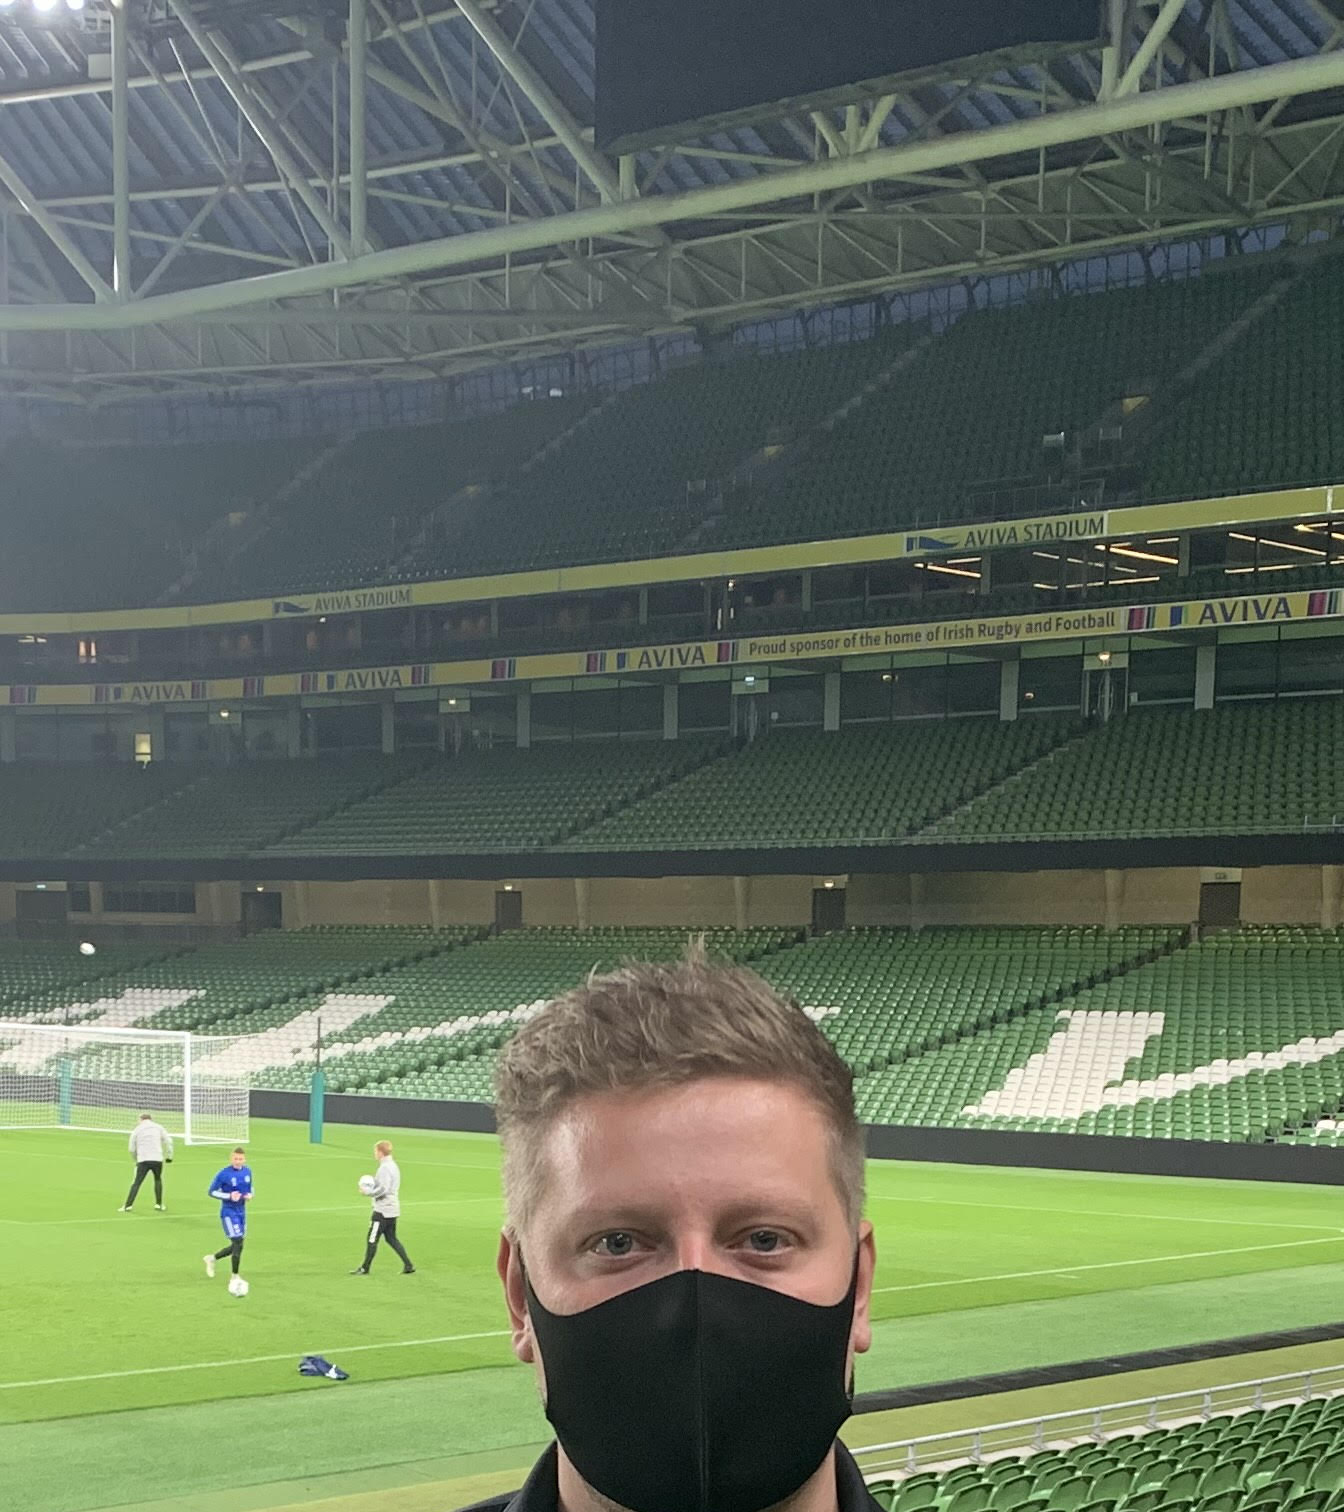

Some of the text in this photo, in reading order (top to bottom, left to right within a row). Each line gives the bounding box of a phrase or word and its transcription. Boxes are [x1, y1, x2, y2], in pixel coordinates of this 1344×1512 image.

[964, 516, 1105, 548] AVIVA STADIUM
[314, 588, 413, 613] AVIVA STADIUM
[1199, 597, 1292, 625] AVIVA
[749, 611, 1115, 656] Proud sponsor of the home of Irish Rugby and Football
[637, 645, 707, 670] AVIVA
[345, 669, 403, 690] AVIVA
[130, 684, 186, 701] AVIVA
